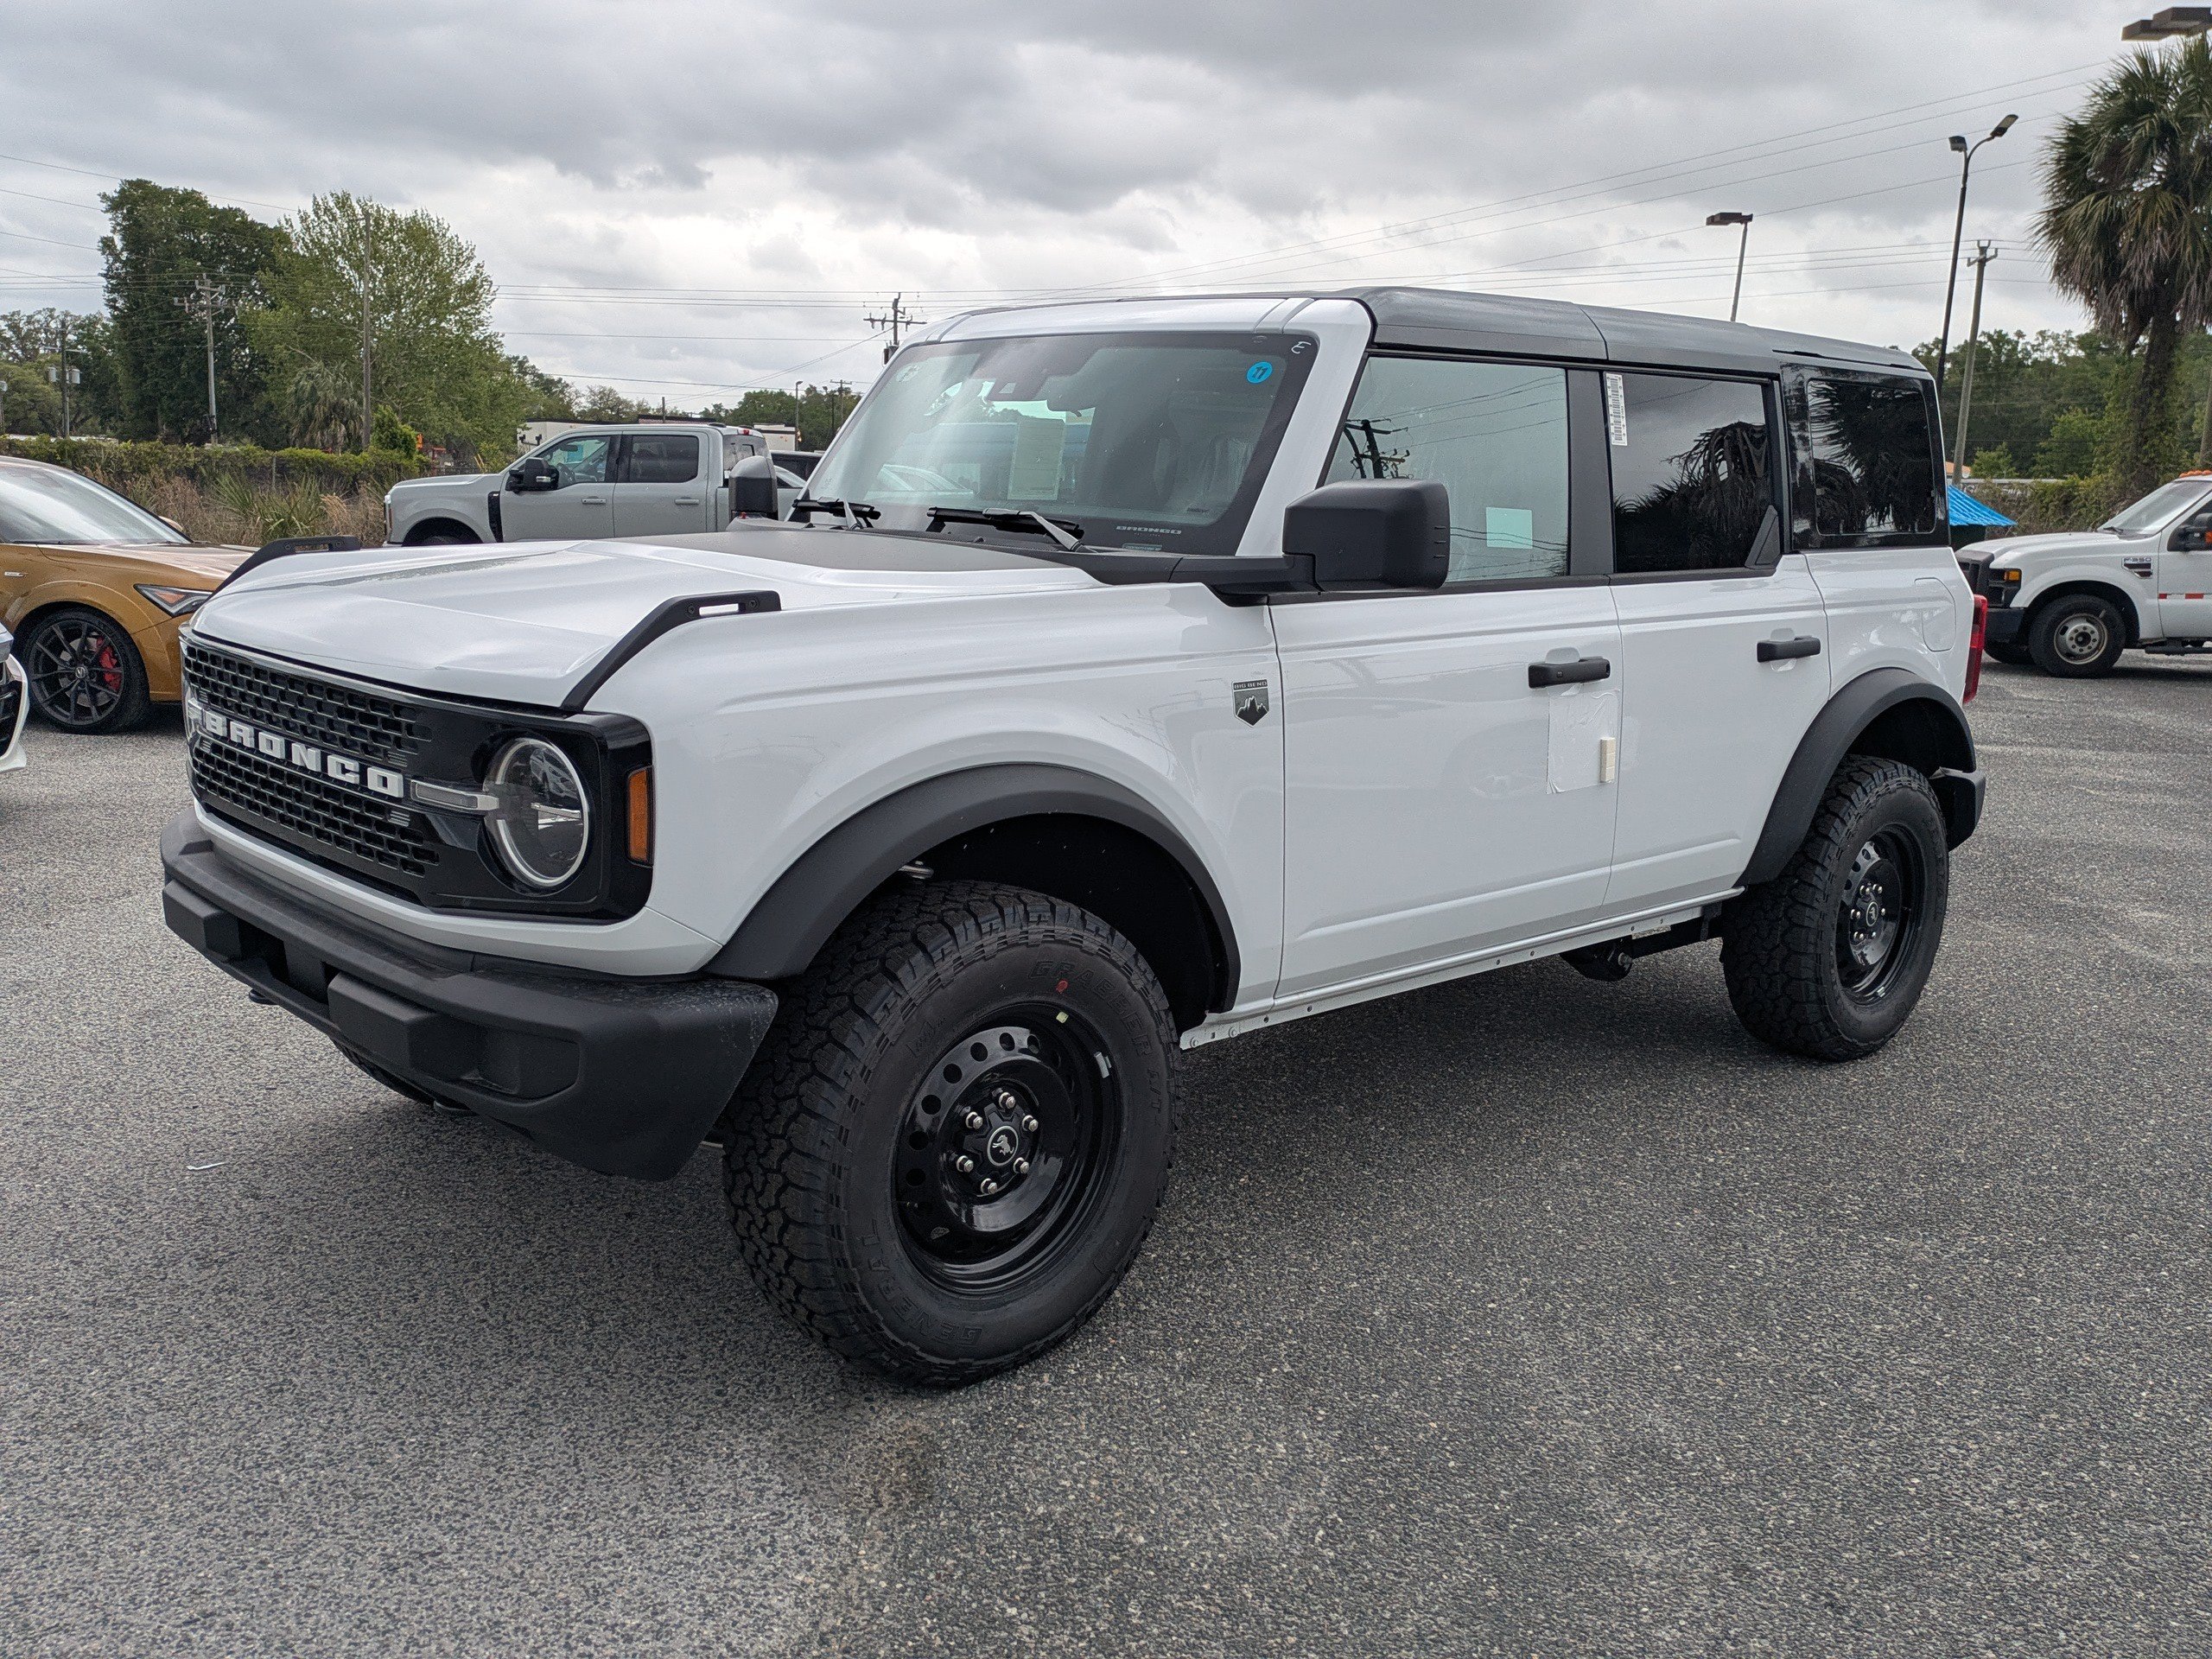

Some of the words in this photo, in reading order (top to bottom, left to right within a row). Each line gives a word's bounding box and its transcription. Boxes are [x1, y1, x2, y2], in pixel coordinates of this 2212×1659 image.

[1116, 525, 1182, 535] BRONCO
[205, 709, 404, 798] BRONCO
[862, 1218, 983, 1346] GENERAL
